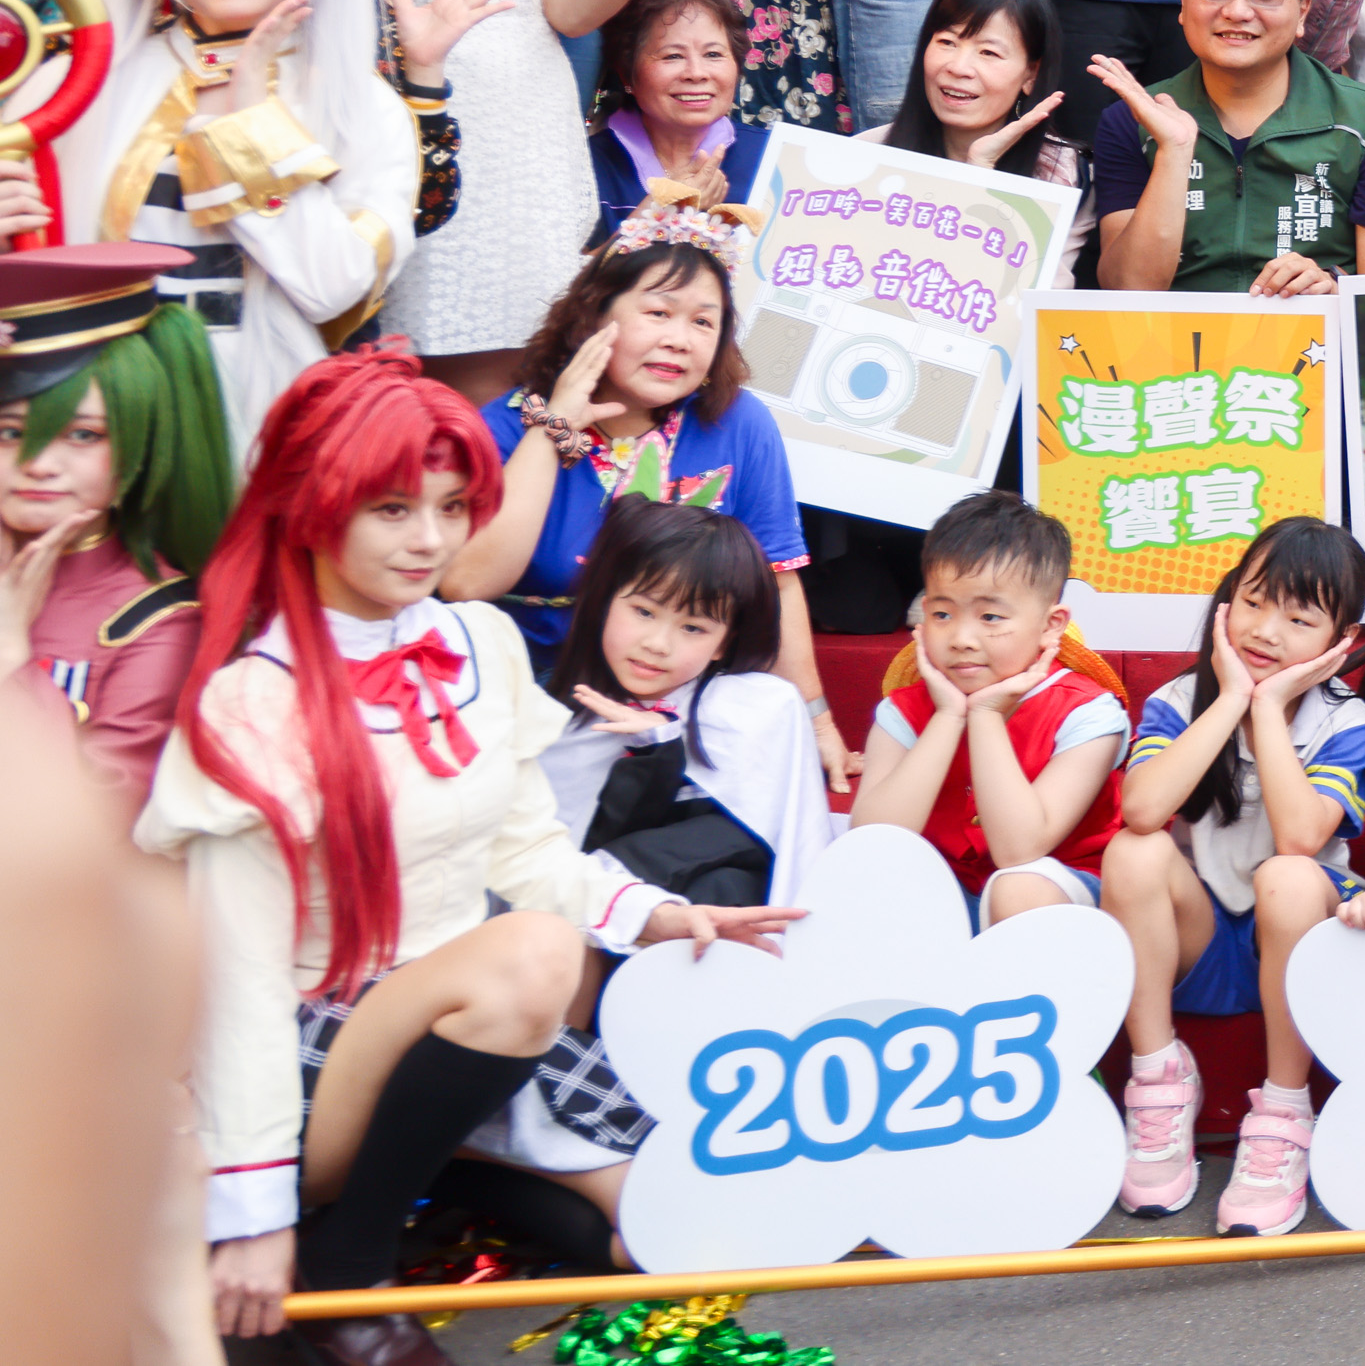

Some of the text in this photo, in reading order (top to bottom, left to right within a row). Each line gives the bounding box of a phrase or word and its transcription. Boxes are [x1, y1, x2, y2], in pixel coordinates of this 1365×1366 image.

[781, 188, 1028, 268] 「回眸一笑百花一生」
[1294, 173, 1319, 242] 廖宜琨
[1315, 162, 1334, 228] 新北市議員
[773, 244, 997, 333] 短影音徵件
[1059, 369, 1303, 455] 漫聲祭
[1102, 465, 1262, 551] 饗宴
[697, 1005, 1052, 1166] 2025
